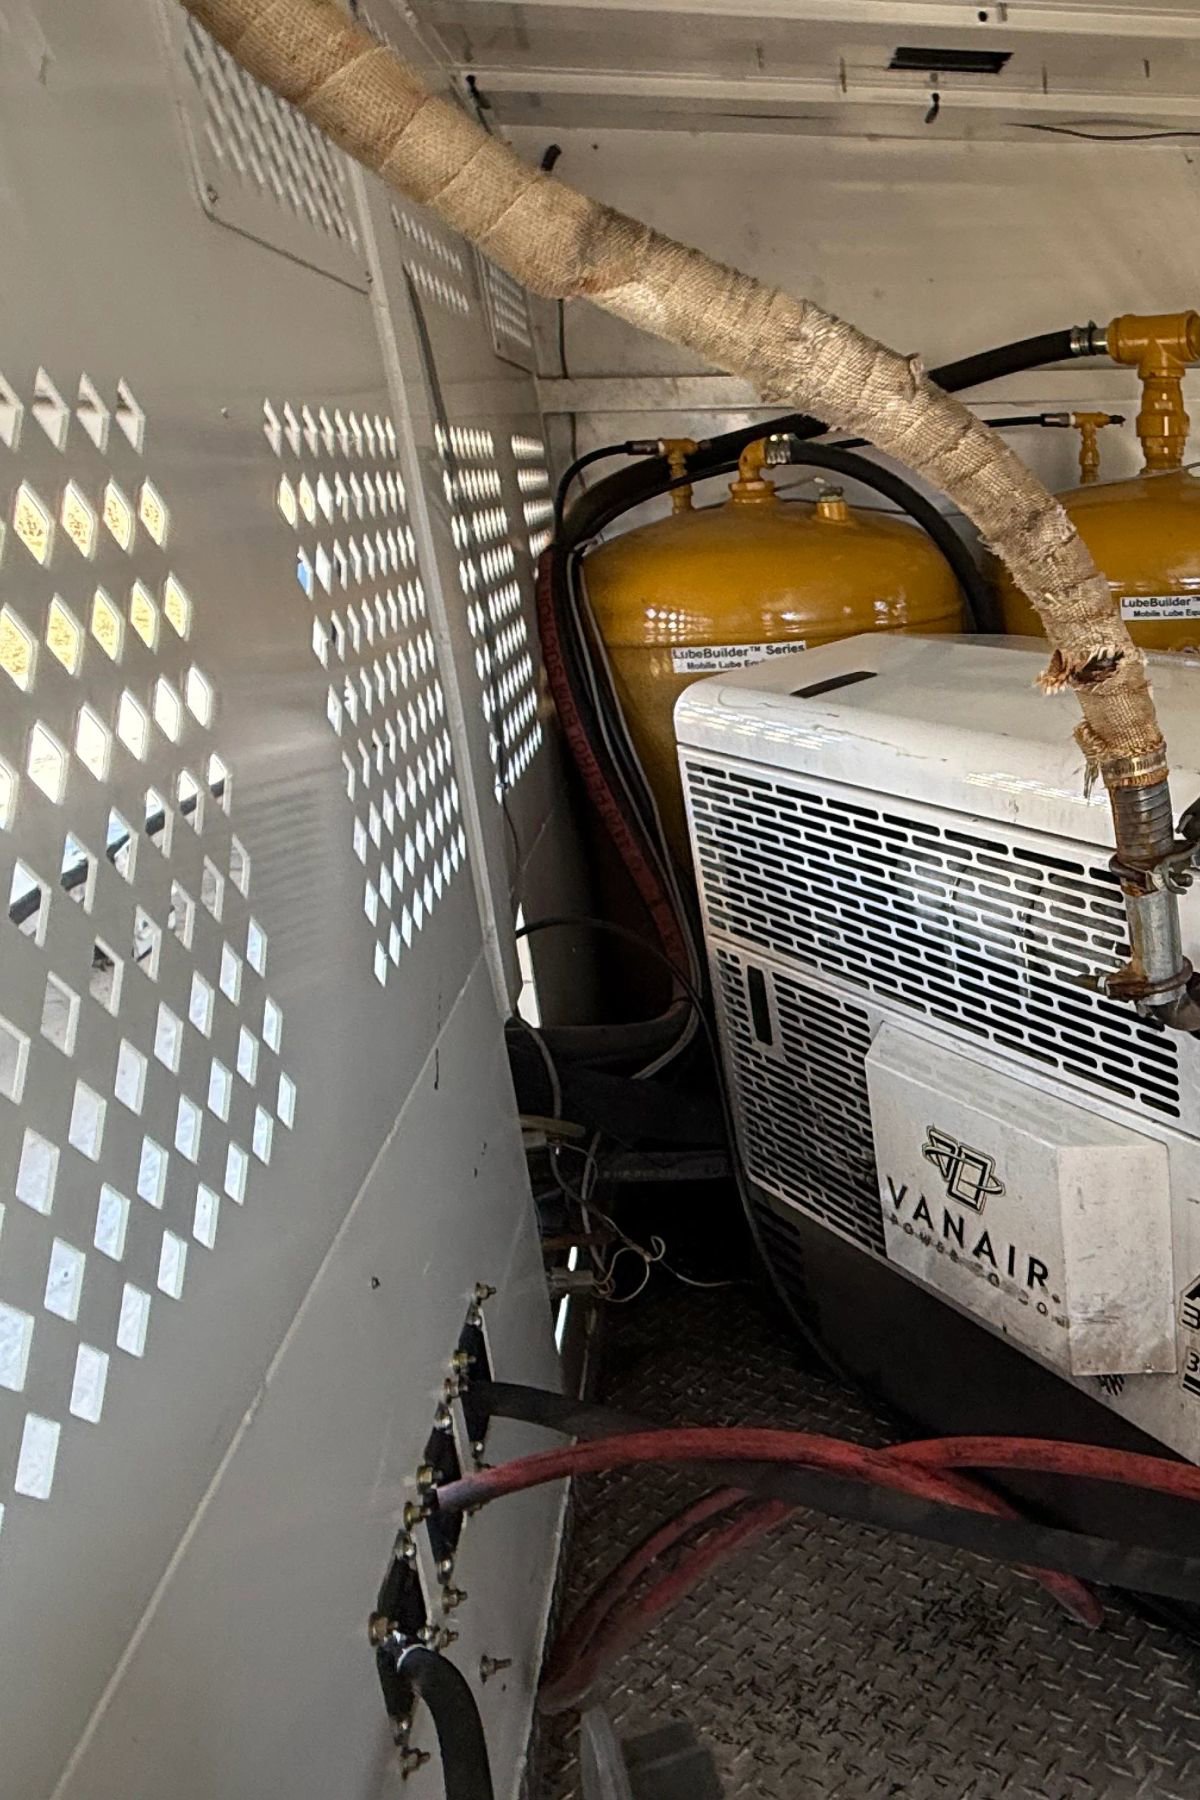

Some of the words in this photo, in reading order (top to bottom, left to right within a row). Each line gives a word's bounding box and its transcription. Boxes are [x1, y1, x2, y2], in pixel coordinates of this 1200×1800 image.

[1133, 610, 1160, 618] Mobile
[1163, 609, 1184, 617] Lube
[766, 643, 805, 655] Series
[687, 661, 716, 670] Mobile
[719, 660, 742, 669] Lube
[886, 1176, 1049, 1290] VANAIR
